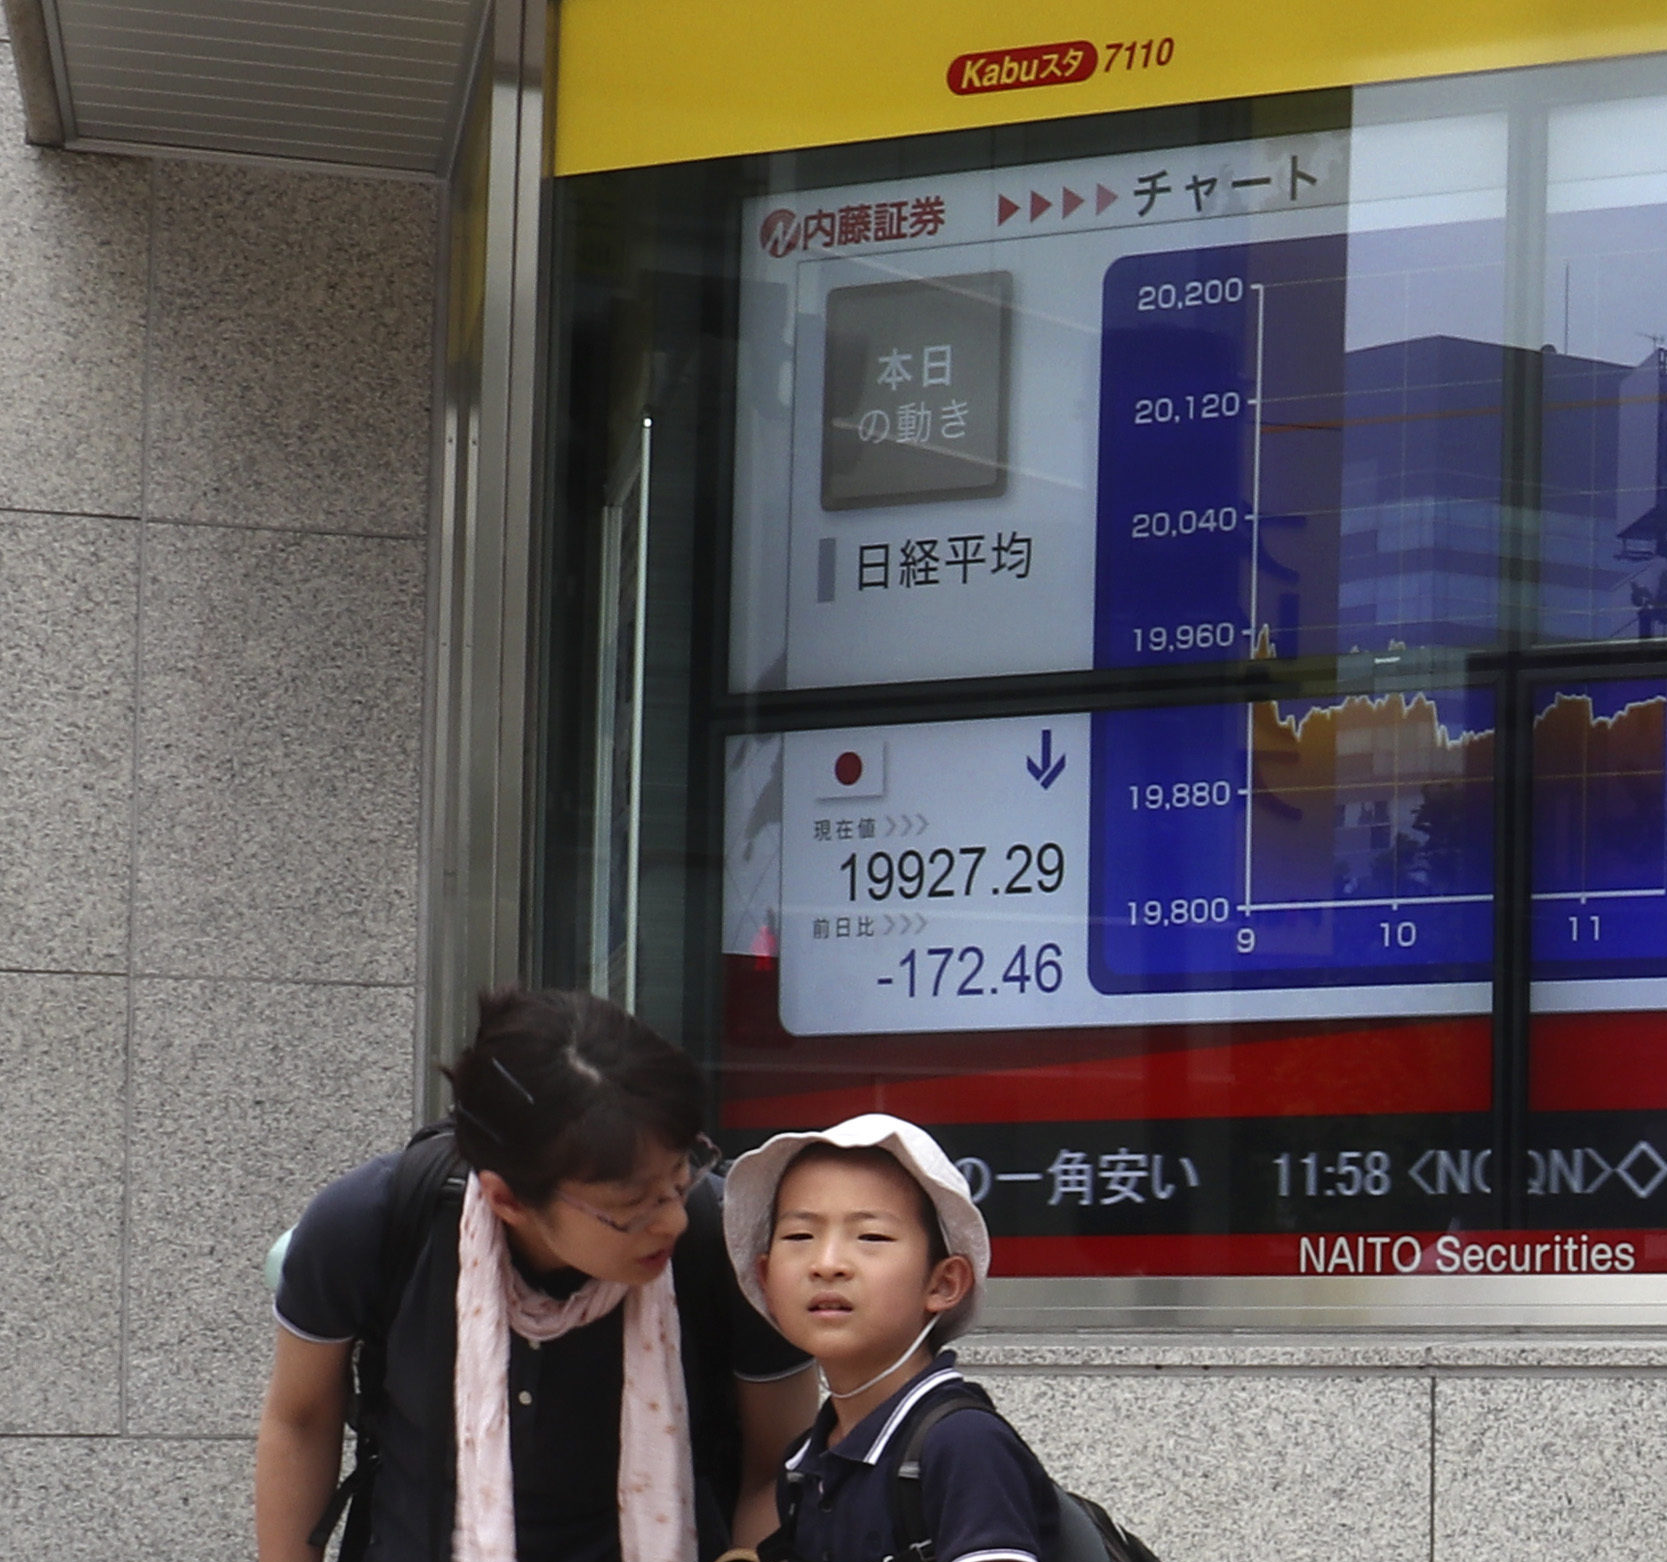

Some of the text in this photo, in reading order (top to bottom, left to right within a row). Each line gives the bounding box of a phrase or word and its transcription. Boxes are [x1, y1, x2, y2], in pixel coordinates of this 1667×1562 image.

[961, 37, 1174, 89] Kabuスタ 7110
[1133, 156, 1317, 218] チャート
[802, 196, 946, 249] 内藤証券
[1137, 278, 1244, 313] 20,200
[877, 344, 953, 392] 本日
[858, 399, 970, 446] の動き
[1135, 392, 1241, 427] 20,120
[1131, 507, 1239, 540] 20,040
[856, 530, 1033, 592] 日経平均
[1133, 622, 1235, 653] 19,960
[1129, 780, 1231, 812] 19,880
[814, 818, 876, 842] 現在値
[840, 843, 1065, 902] 19927.29
[813, 916, 875, 939] 前日比
[1127, 898, 1230, 928] 19,800
[1569, 915, 1602, 942] 11
[1236, 929, 1256, 954] 9
[1380, 921, 1417, 948] 10
[877, 943, 1063, 998] -172.46
[1272, 1150, 1392, 1198] 11:58
[1300, 1234, 1636, 1273] NAITO Securities
